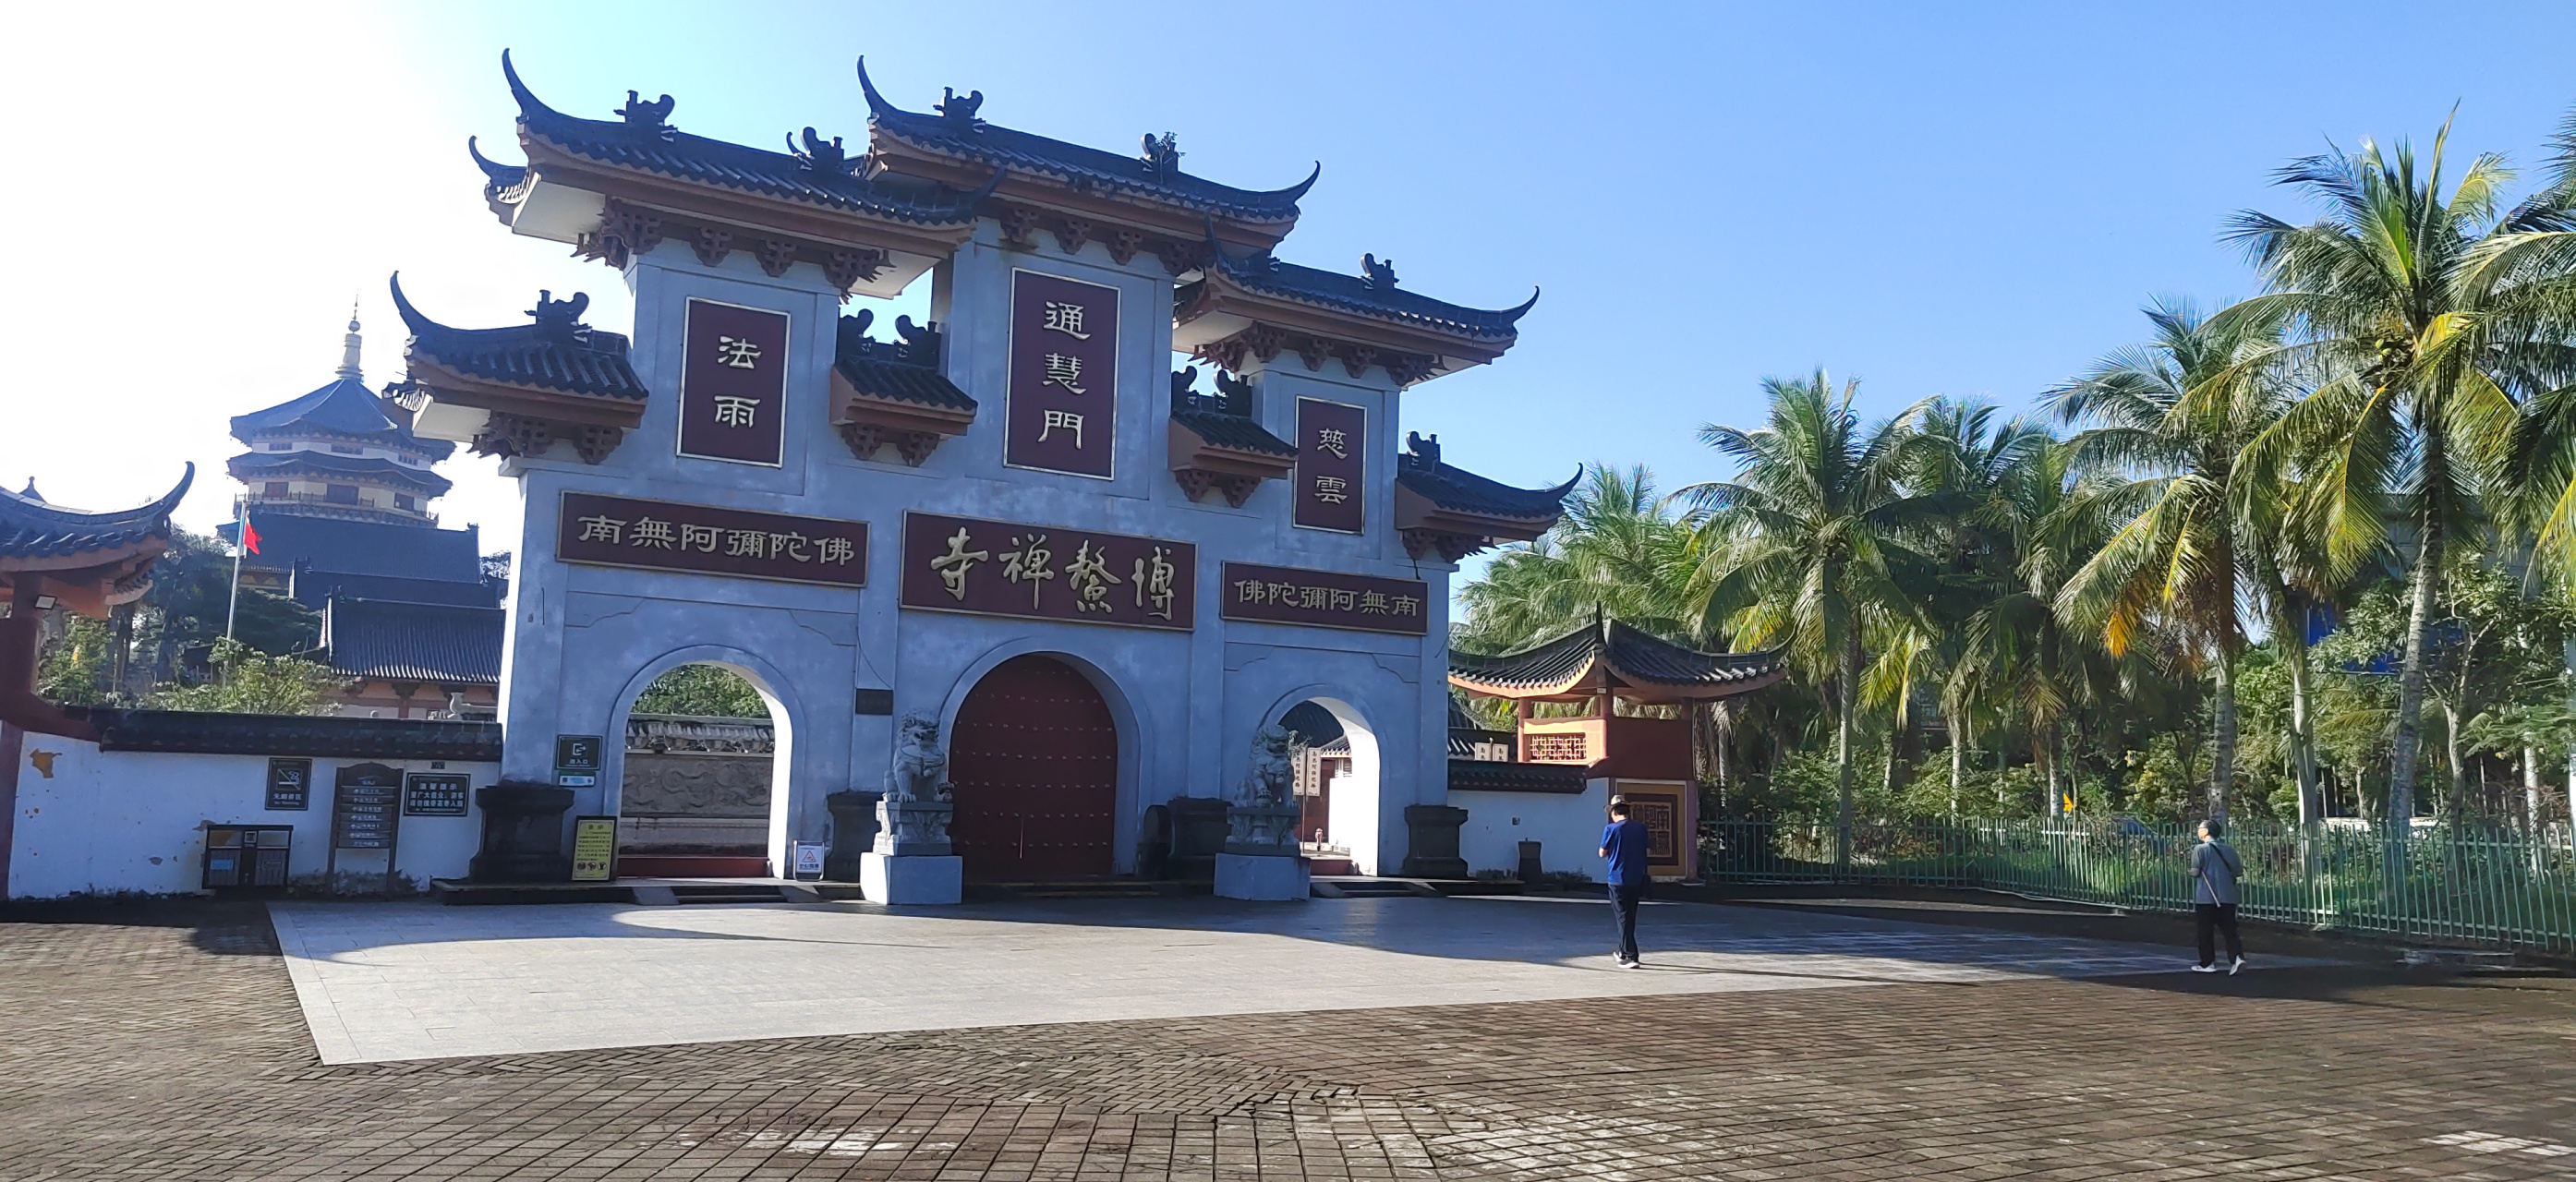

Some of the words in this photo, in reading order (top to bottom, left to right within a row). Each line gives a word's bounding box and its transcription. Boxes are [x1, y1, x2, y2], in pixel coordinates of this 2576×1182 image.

[713, 334, 762, 428] 法雨
[1037, 300, 1092, 450] 通慧門
[1313, 427, 1348, 505] 慈雲
[576, 513, 856, 567] 南無阿彌陀佛
